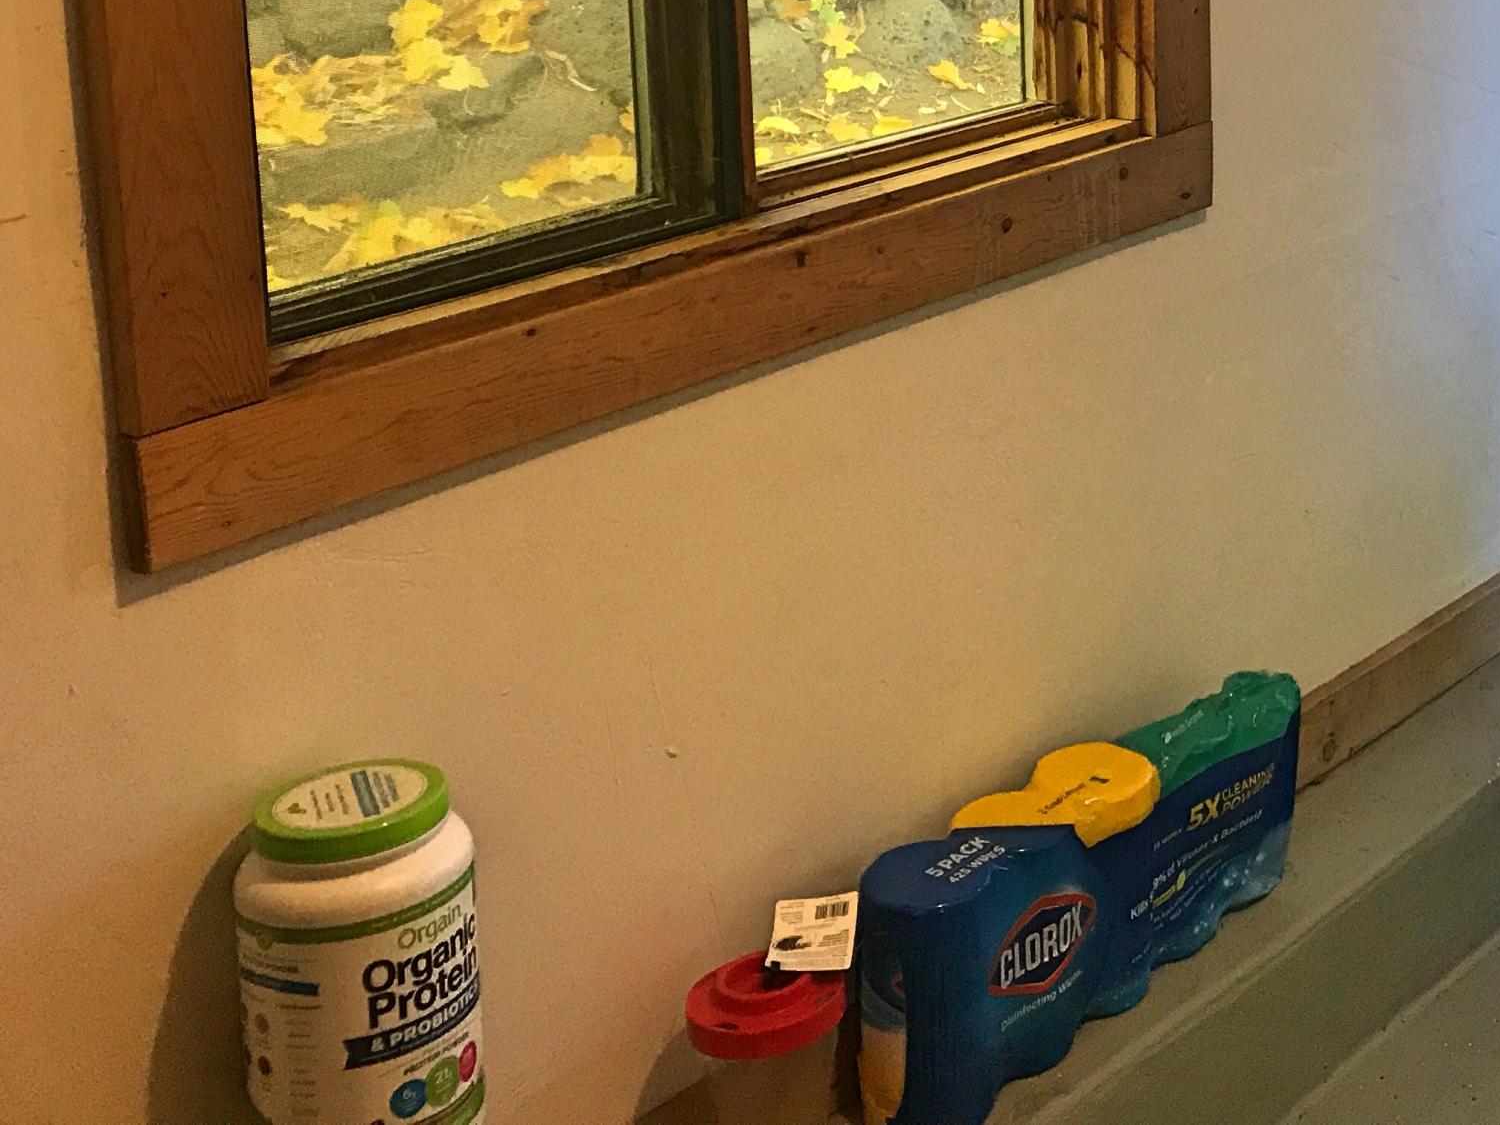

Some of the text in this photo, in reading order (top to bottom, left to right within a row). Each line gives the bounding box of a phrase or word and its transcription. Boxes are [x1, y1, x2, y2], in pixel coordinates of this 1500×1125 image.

[1186, 792, 1221, 831] 5X
[925, 836, 991, 878] 5 PACK
[397, 904, 461, 950] Orgain
[1000, 900, 1082, 989] CLOROX
[362, 912, 476, 993] Organic
[367, 946, 477, 1029] Protein
[371, 1037, 385, 1053] &
